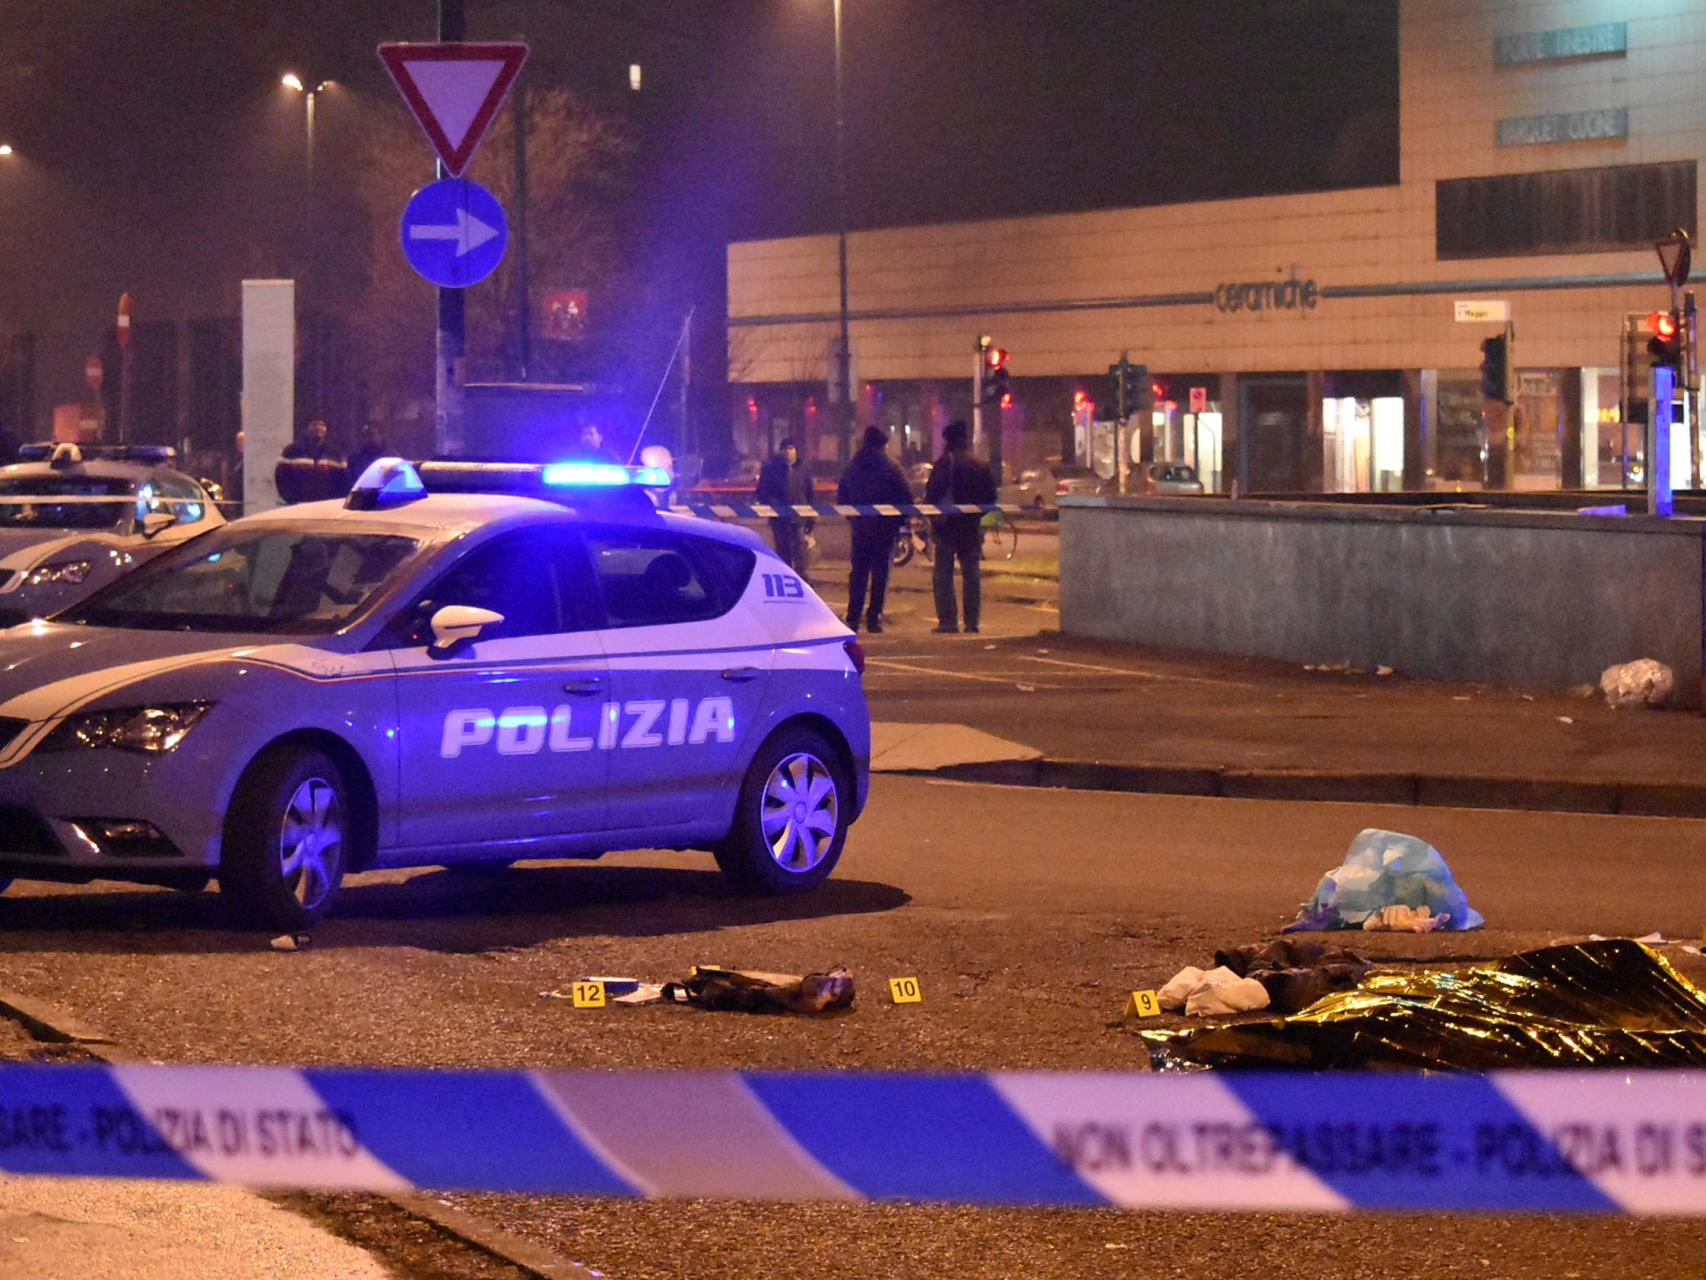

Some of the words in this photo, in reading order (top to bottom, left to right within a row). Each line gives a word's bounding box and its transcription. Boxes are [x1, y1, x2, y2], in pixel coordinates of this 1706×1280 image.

[1216, 263, 1317, 313] ceramiche
[762, 574, 804, 598] 113
[440, 696, 735, 758] POLIZIA
[577, 985, 600, 1001] 12
[894, 981, 915, 997] 10
[1141, 994, 1151, 1010] 9
[94, 1103, 214, 1155] POLIZIA
[217, 1107, 249, 1157] DI
[256, 1107, 359, 1159] STATO
[1053, 1121, 1133, 1171] NON
[1140, 1121, 1440, 1177] OLTREPASSARE
[1473, 1121, 1625, 1177] POLIZIA
[1634, 1122, 1672, 1177] DI
